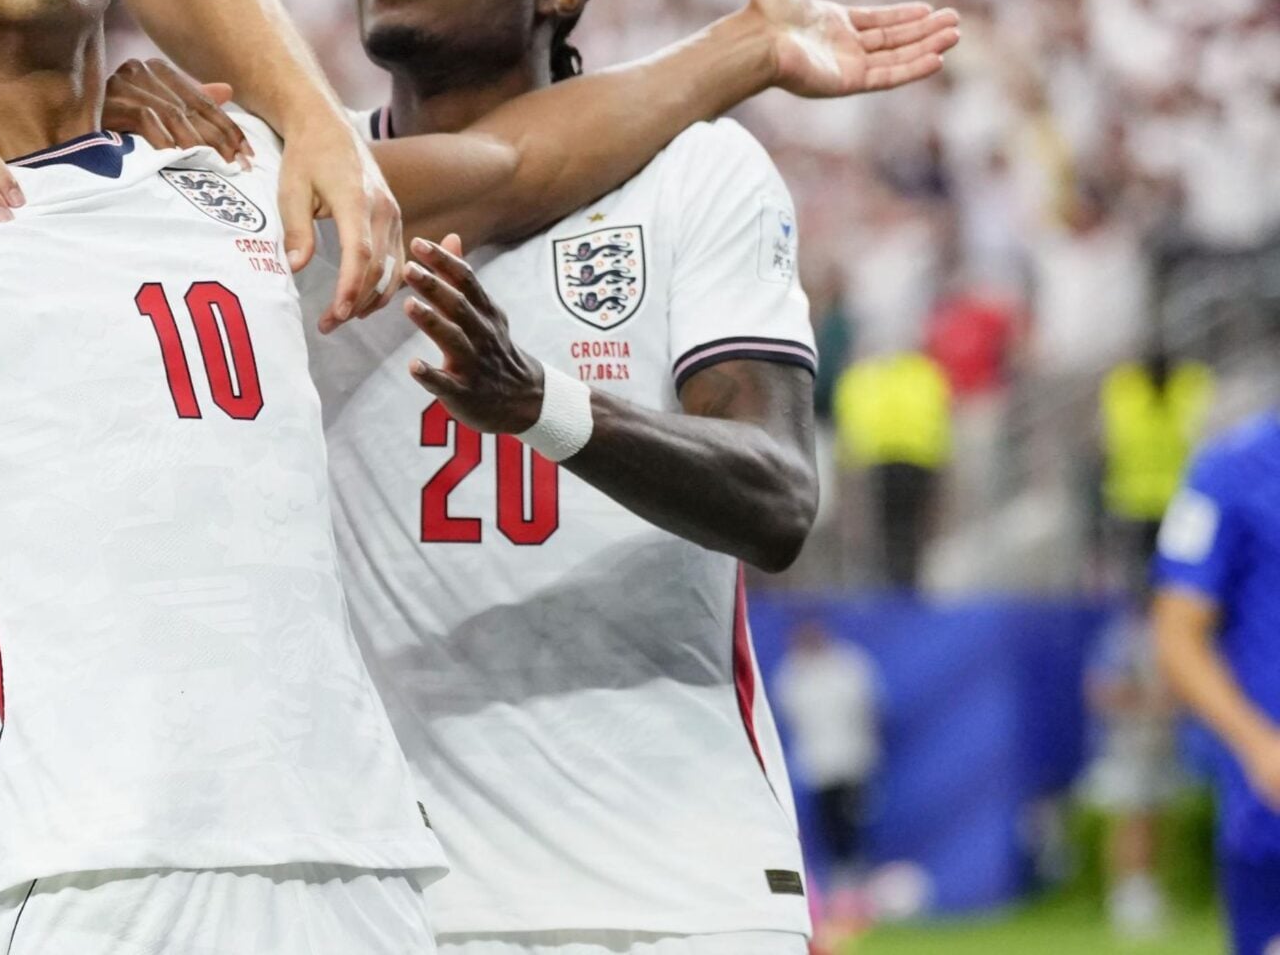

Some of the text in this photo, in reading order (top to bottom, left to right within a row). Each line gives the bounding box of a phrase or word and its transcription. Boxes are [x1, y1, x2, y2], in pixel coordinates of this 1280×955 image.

[134, 280, 264, 420] 10
[571, 341, 630, 358] CROATIA
[420, 398, 559, 545] 20
